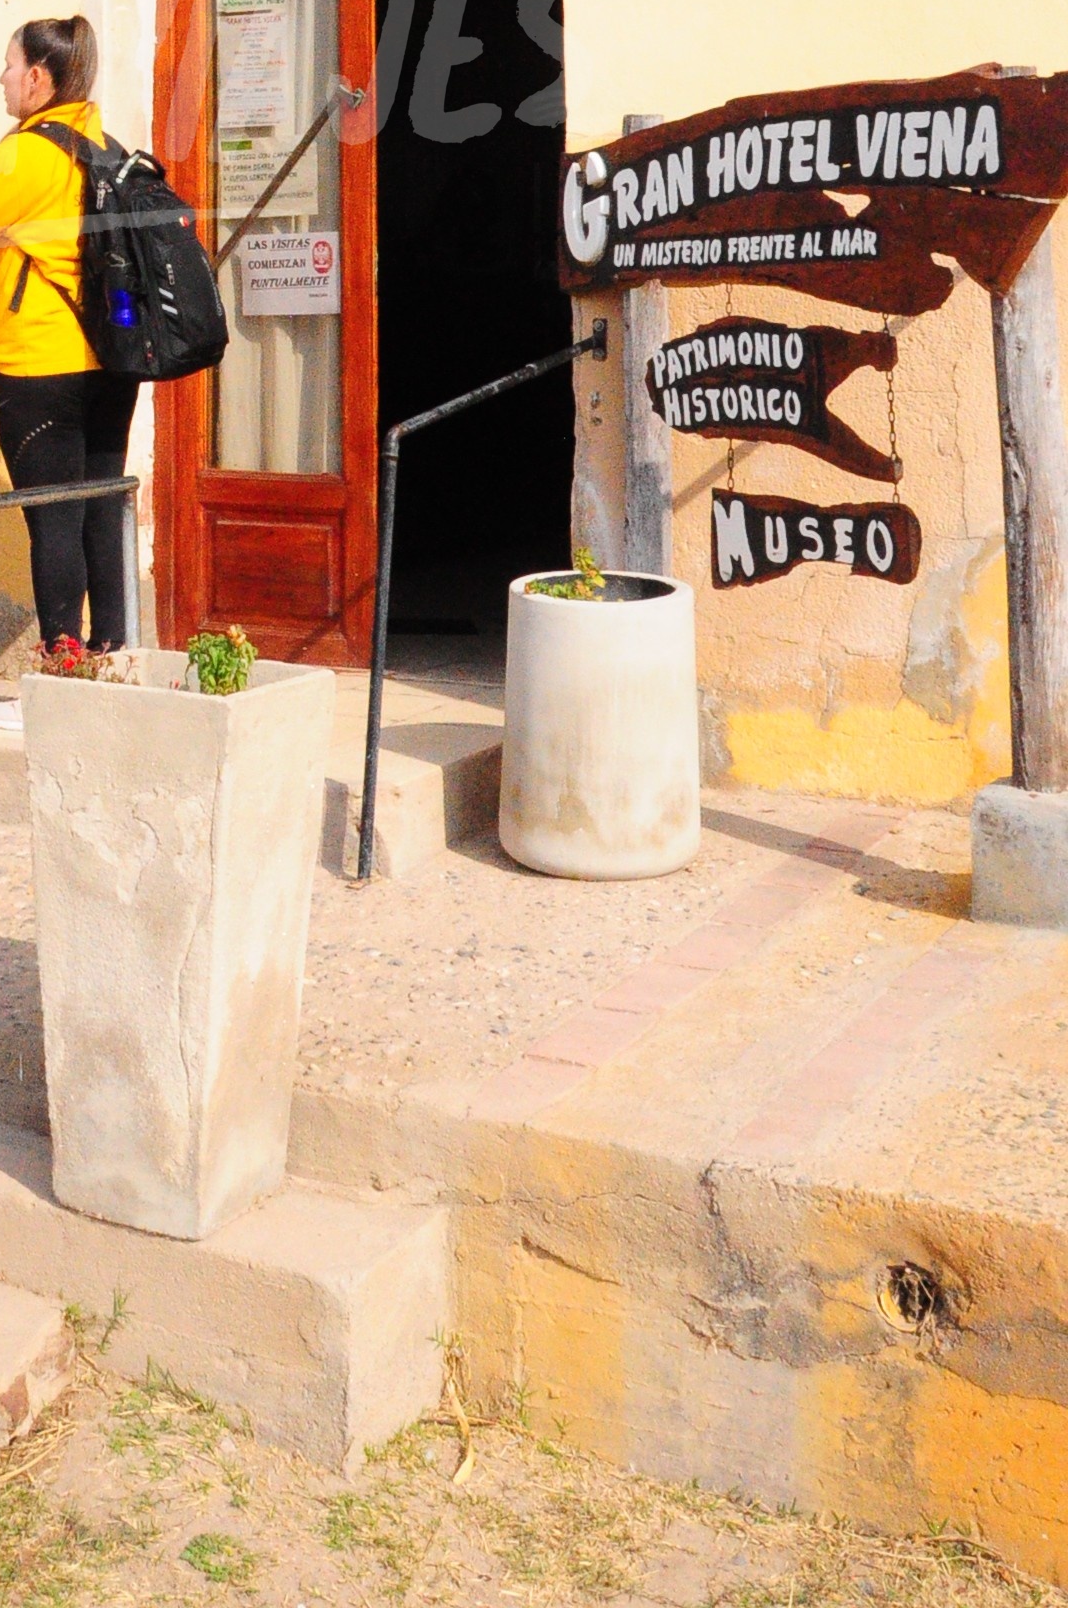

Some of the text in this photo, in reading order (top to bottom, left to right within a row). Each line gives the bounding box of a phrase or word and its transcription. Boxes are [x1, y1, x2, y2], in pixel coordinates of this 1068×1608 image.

[564, 106, 999, 264] GRAN HOTEL VIENA
[248, 238, 311, 250] LAS VISITAS
[613, 229, 877, 267] UN MISTERIO FRENTE AL MAR
[248, 259, 306, 270] COMIENZAN
[250, 276, 330, 288] PUNTUALMENTE
[653, 332, 803, 388] PATRIMONIO
[663, 385, 801, 427] HISTORICO
[713, 499, 894, 581] MUSEO
